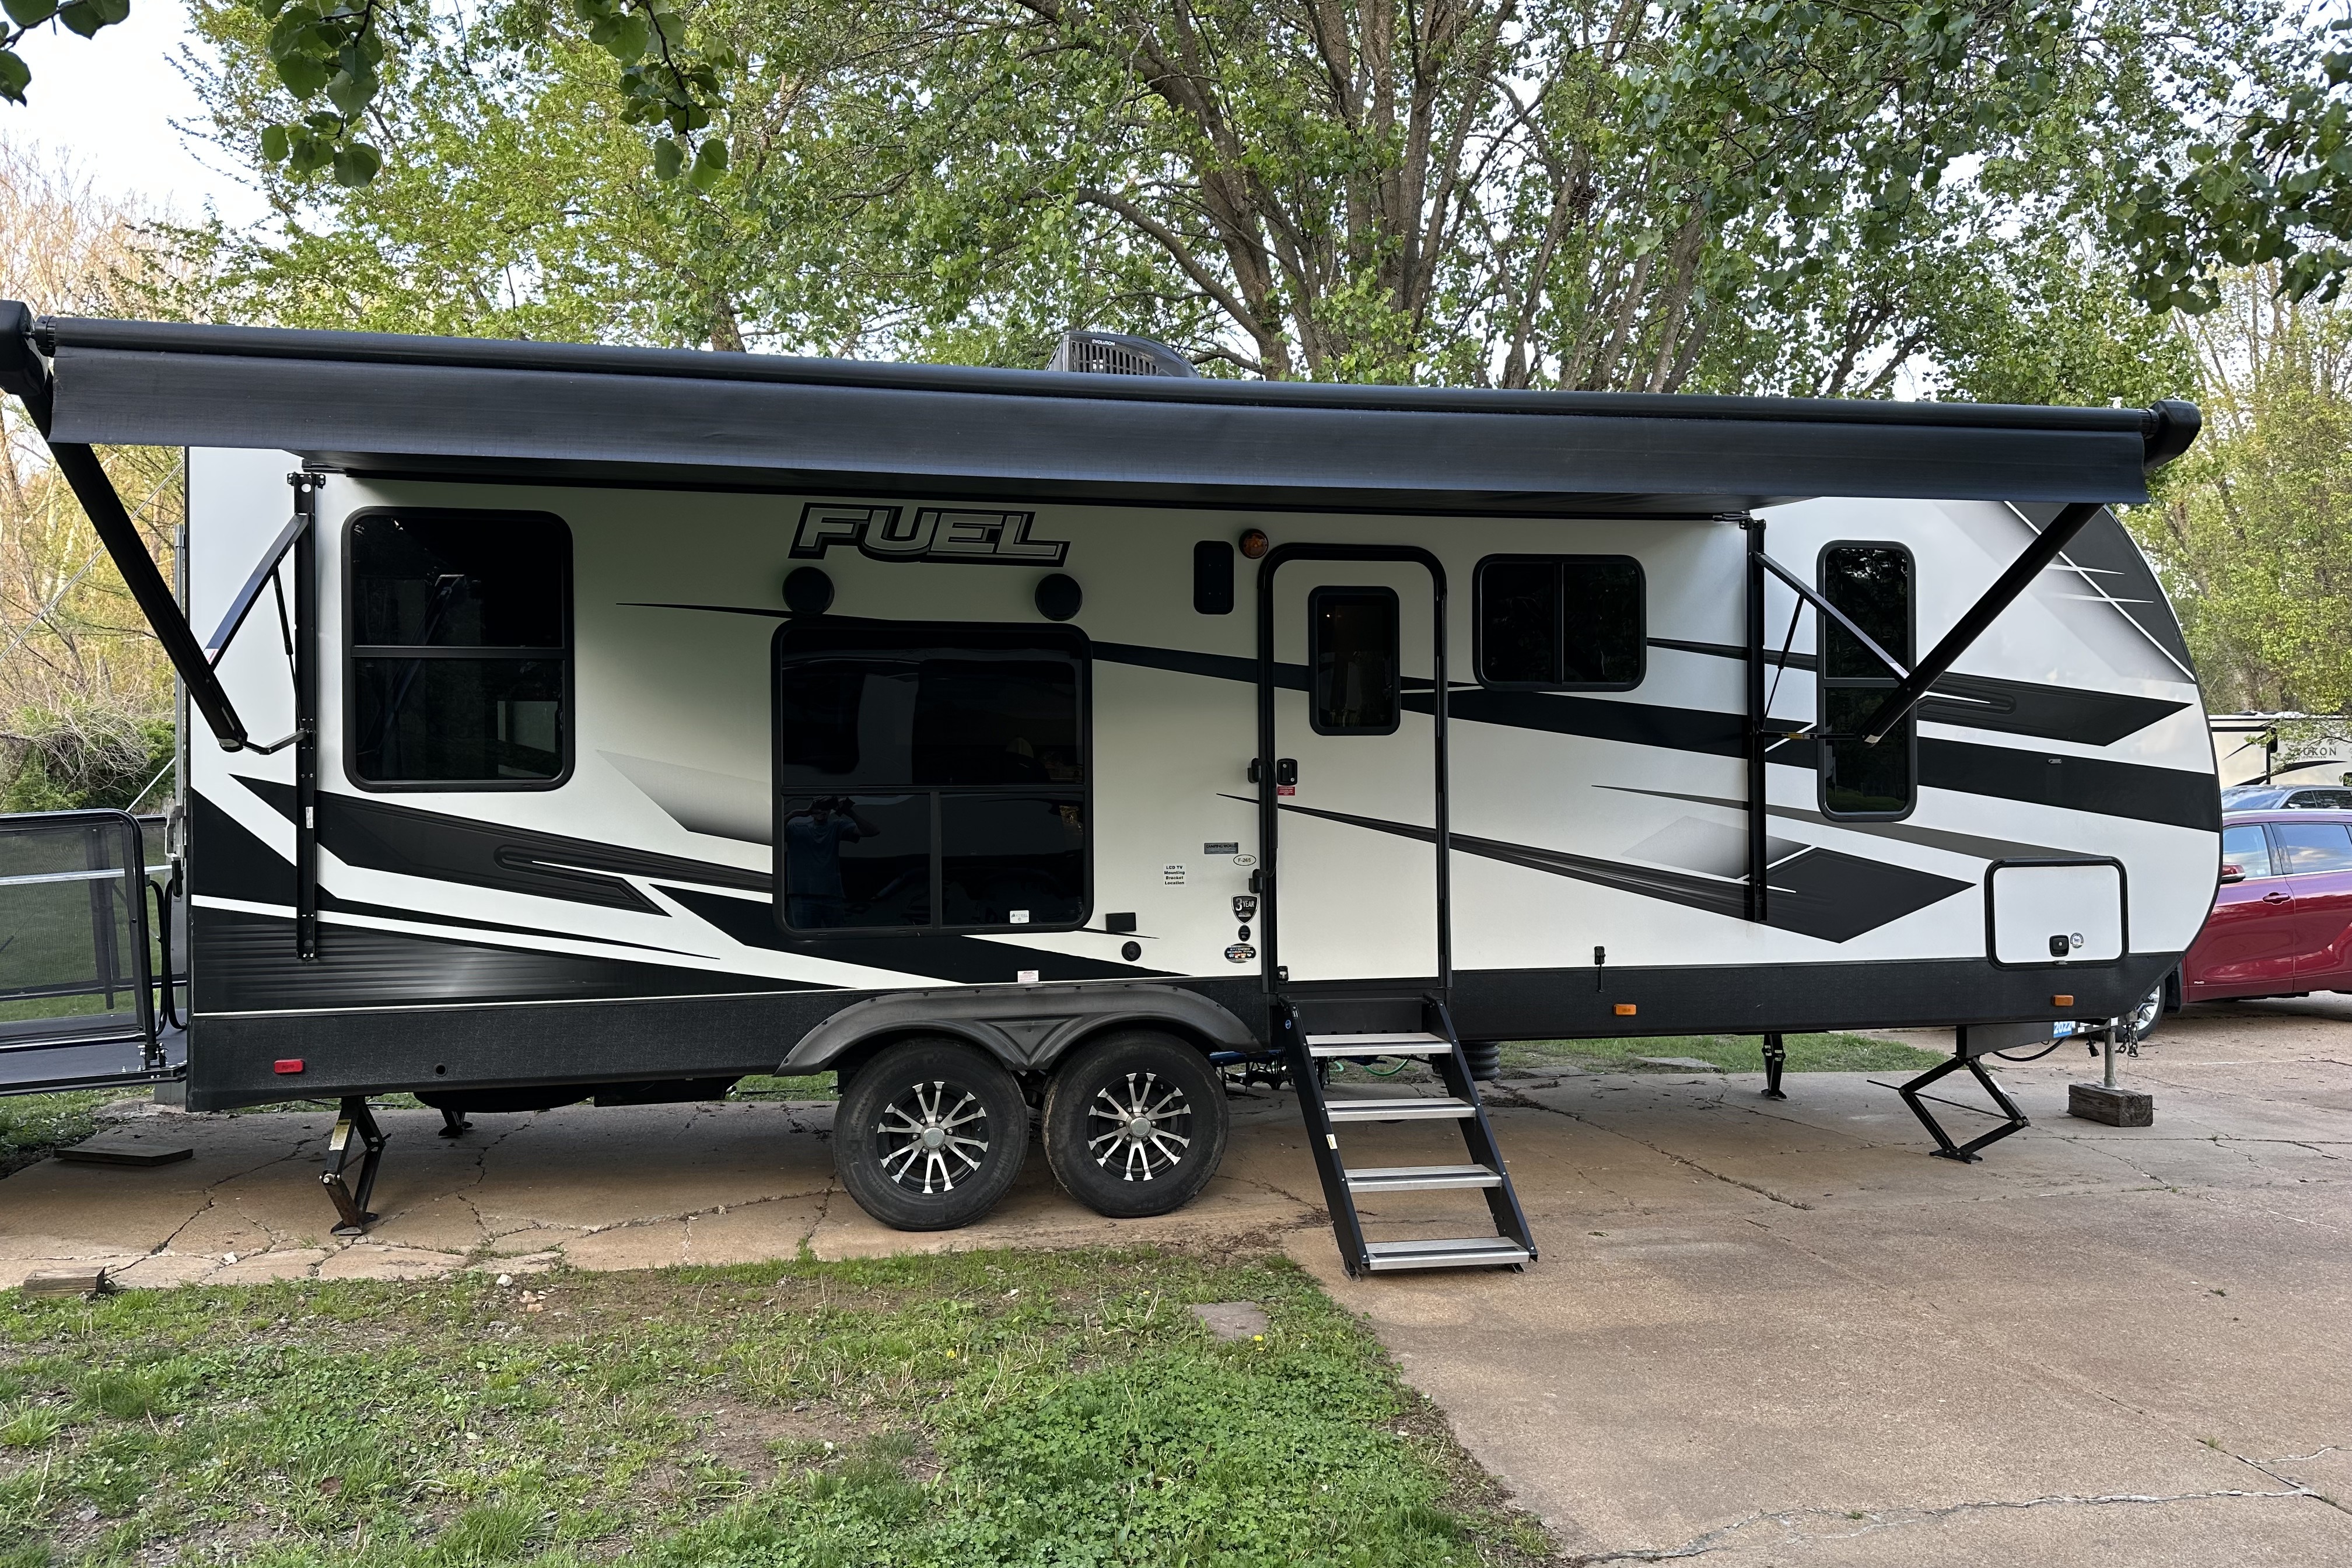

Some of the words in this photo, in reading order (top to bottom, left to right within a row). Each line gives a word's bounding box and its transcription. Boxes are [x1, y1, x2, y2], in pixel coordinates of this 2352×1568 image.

[788, 502, 1071, 568] FUEL
[2301, 747, 2336, 756] UKON
[1235, 897, 1242, 911] 3
[2053, 1021, 2072, 1034] 2022
